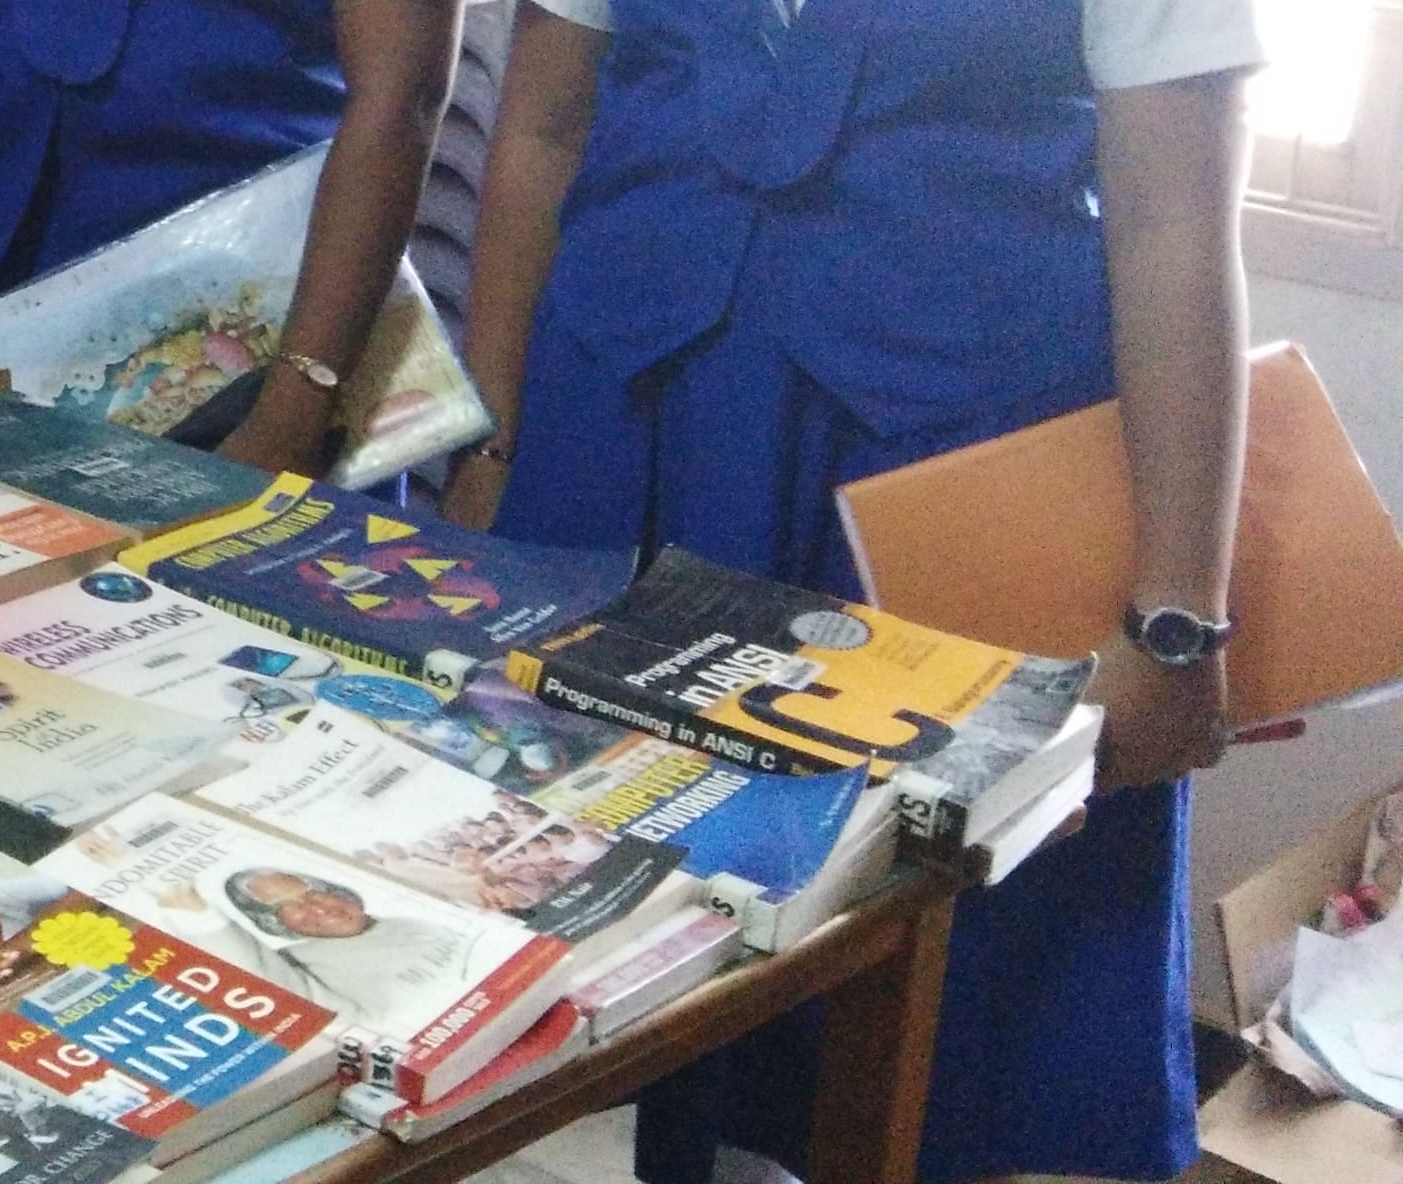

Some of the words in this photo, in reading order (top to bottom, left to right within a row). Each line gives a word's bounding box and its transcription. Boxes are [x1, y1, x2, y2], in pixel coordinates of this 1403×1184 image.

[23, 604, 203, 670] COMMUNICATIONS
[624, 631, 736, 687] Programming
[696, 643, 784, 698] ANSI
[17, 722, 99, 753] India
[544, 677, 672, 740] Programming
[677, 724, 697, 743] in
[701, 729, 755, 763] ANSI
[759, 751, 777, 770] C
[738, 681, 956, 763] C
[269, 772, 315, 805] Kalam
[313, 737, 360, 777] Effect
[94, 820, 225, 899] NDOMITABLE
[158, 843, 229, 884] SPIRIT
[56, 984, 116, 1028] ABDUL
[110, 948, 177, 991] KALAM
[37, 965, 221, 1079] IGNITED
[43, 1127, 116, 1176] CHANGE
